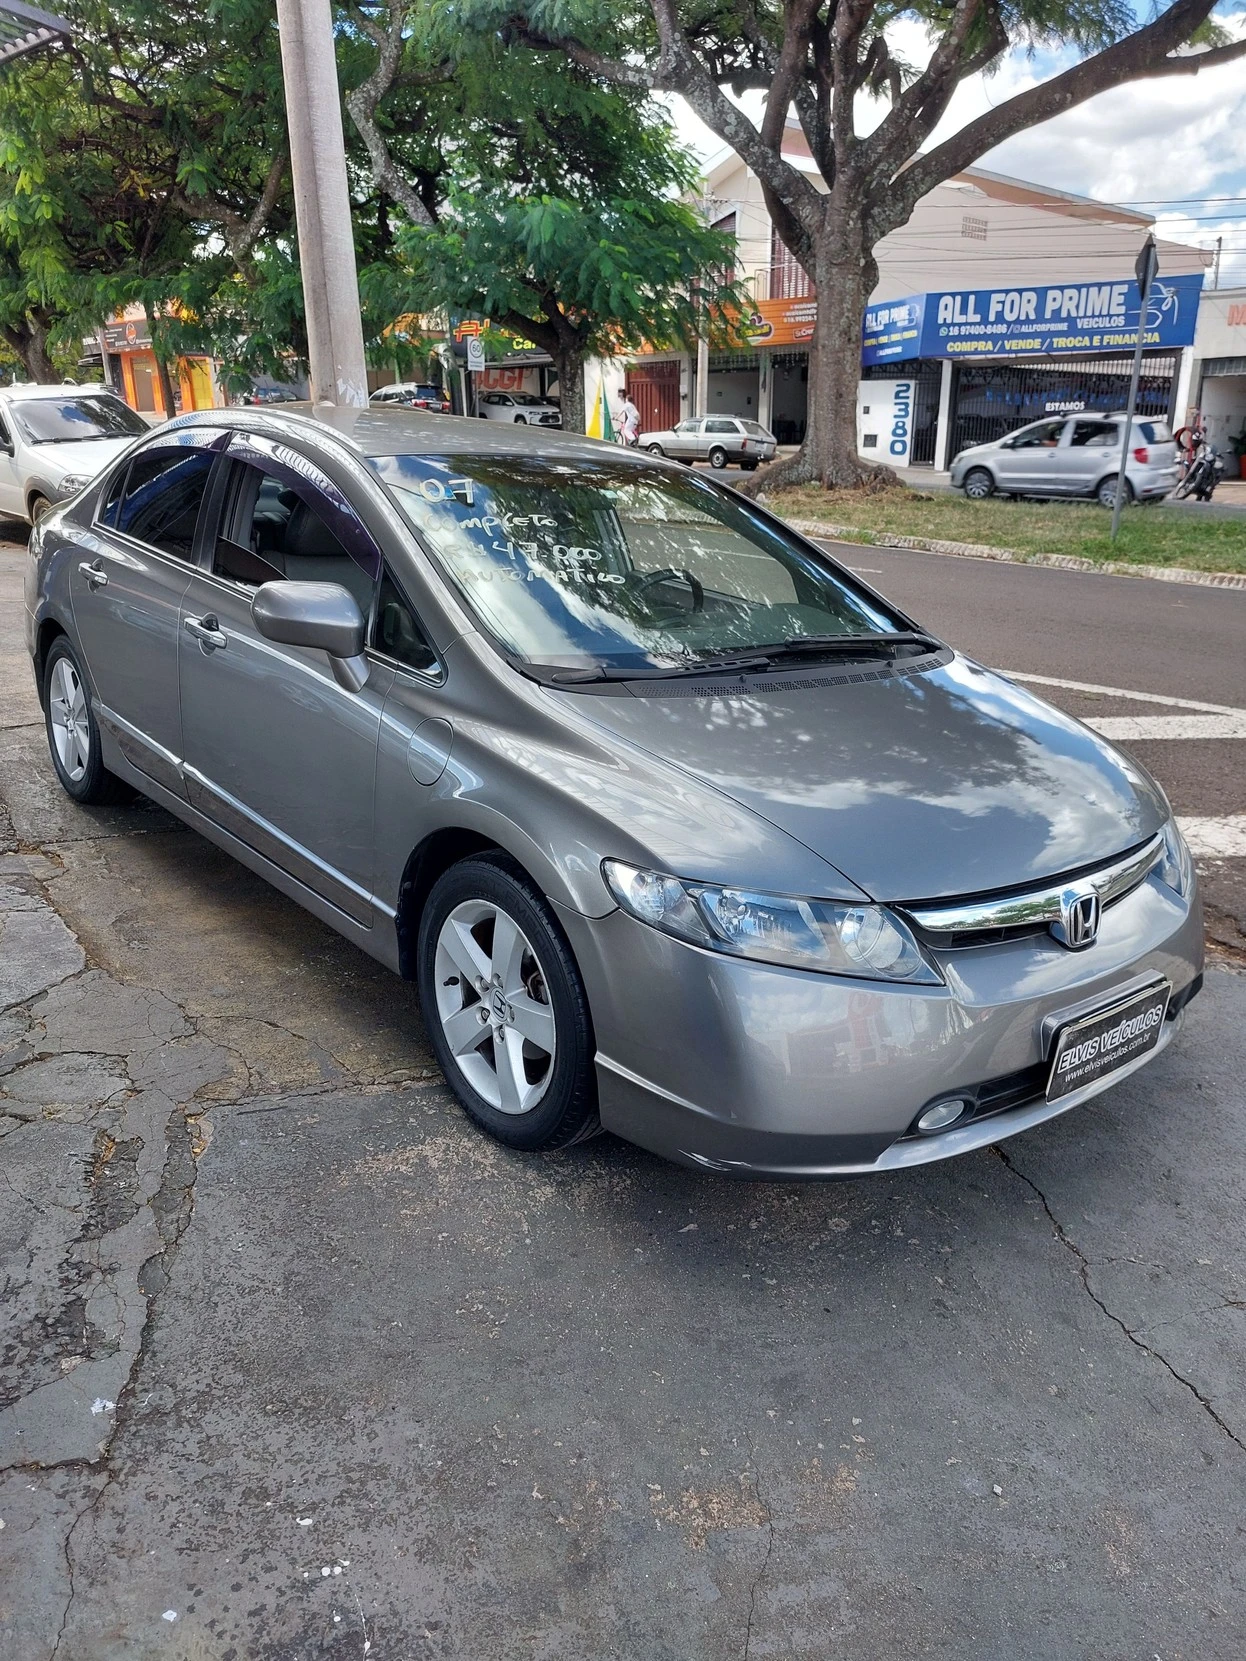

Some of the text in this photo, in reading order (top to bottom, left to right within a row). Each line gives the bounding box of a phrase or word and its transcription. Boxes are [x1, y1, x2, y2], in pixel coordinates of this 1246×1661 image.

[937, 284, 1129, 324] ALL FOR PRIME
[1076, 315, 1126, 329] VEICULOS
[948, 325, 959, 336] 16
[471, 343, 481, 353] 60
[946, 340, 993, 352] COMPRA
[1004, 338, 1042, 350] VENDE
[1052, 336, 1091, 348] TROCA
[1092, 335, 1101, 346] E
[1045, 401, 1085, 412] ESTAMOS
[1057, 1036, 1100, 1074] ELVIS
